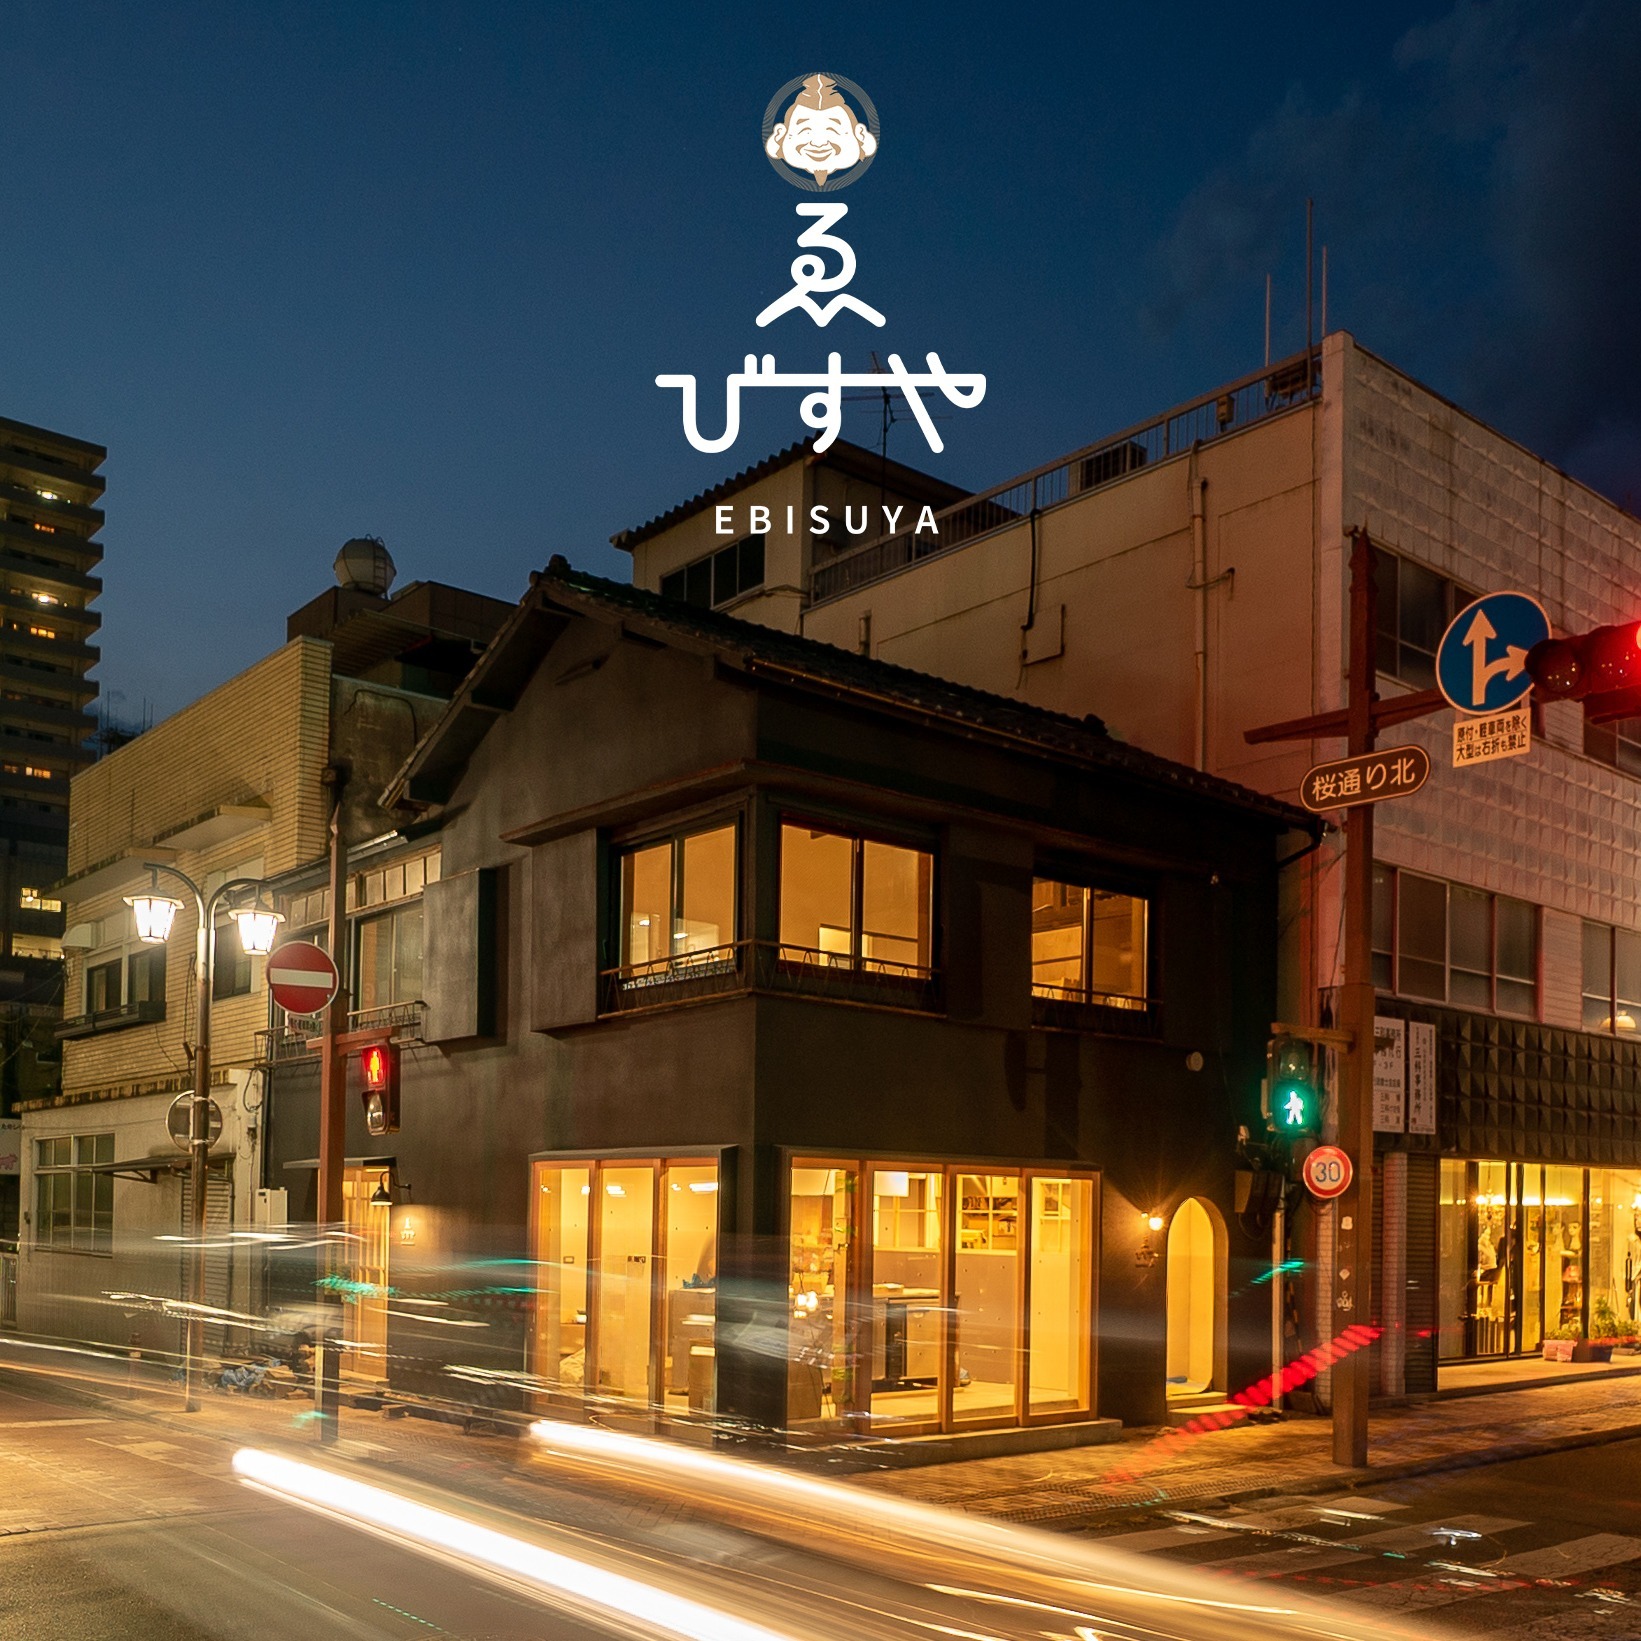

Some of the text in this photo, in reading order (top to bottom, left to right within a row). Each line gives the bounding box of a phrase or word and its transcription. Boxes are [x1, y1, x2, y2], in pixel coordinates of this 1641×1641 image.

[1311, 757, 1416, 802] 桜通り北
[1316, 1161, 1340, 1182] 30
